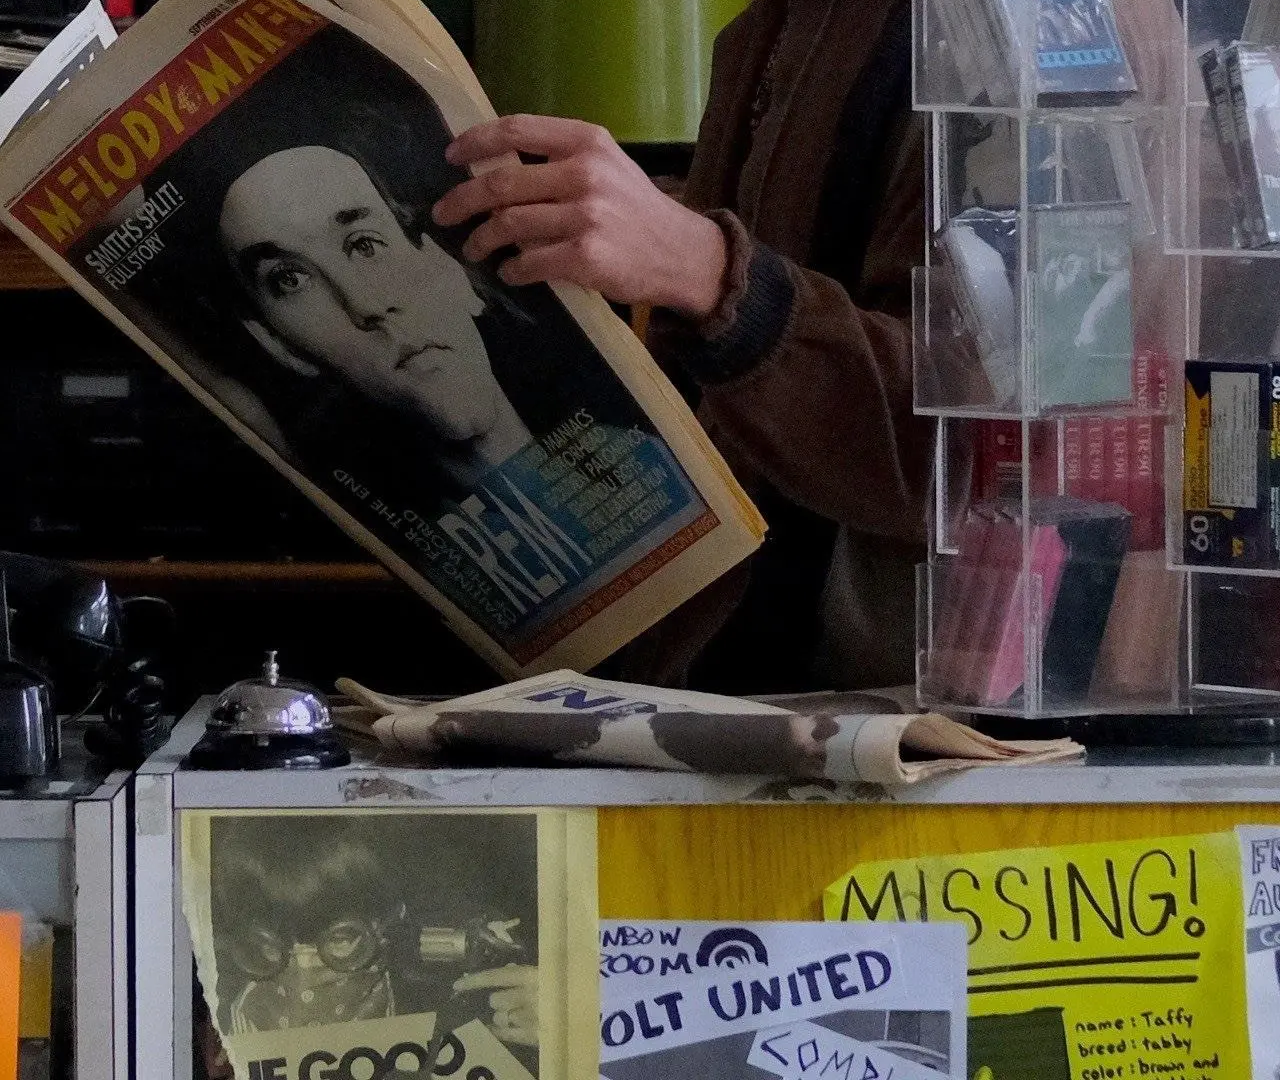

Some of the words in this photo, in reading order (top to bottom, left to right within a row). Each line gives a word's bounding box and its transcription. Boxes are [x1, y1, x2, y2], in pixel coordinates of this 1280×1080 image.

[26, 83, 186, 243] MELODY
[85, 203, 144, 275] SMITHS
[140, 180, 185, 232] SPLIT!
[332, 469, 371, 500] END
[369, 498, 403, 529] THE
[1190, 515, 1209, 552] 60
[437, 469, 593, 617] REM
[840, 849, 1206, 946] MISSING!
[707, 950, 892, 1021] UNITED
[600, 991, 683, 1047] OLT
[1141, 1007, 1193, 1028] Taffy
[1138, 1057, 1185, 1076] brown
[1193, 1052, 1220, 1069] and
[1142, 1033, 1192, 1054] tabby
